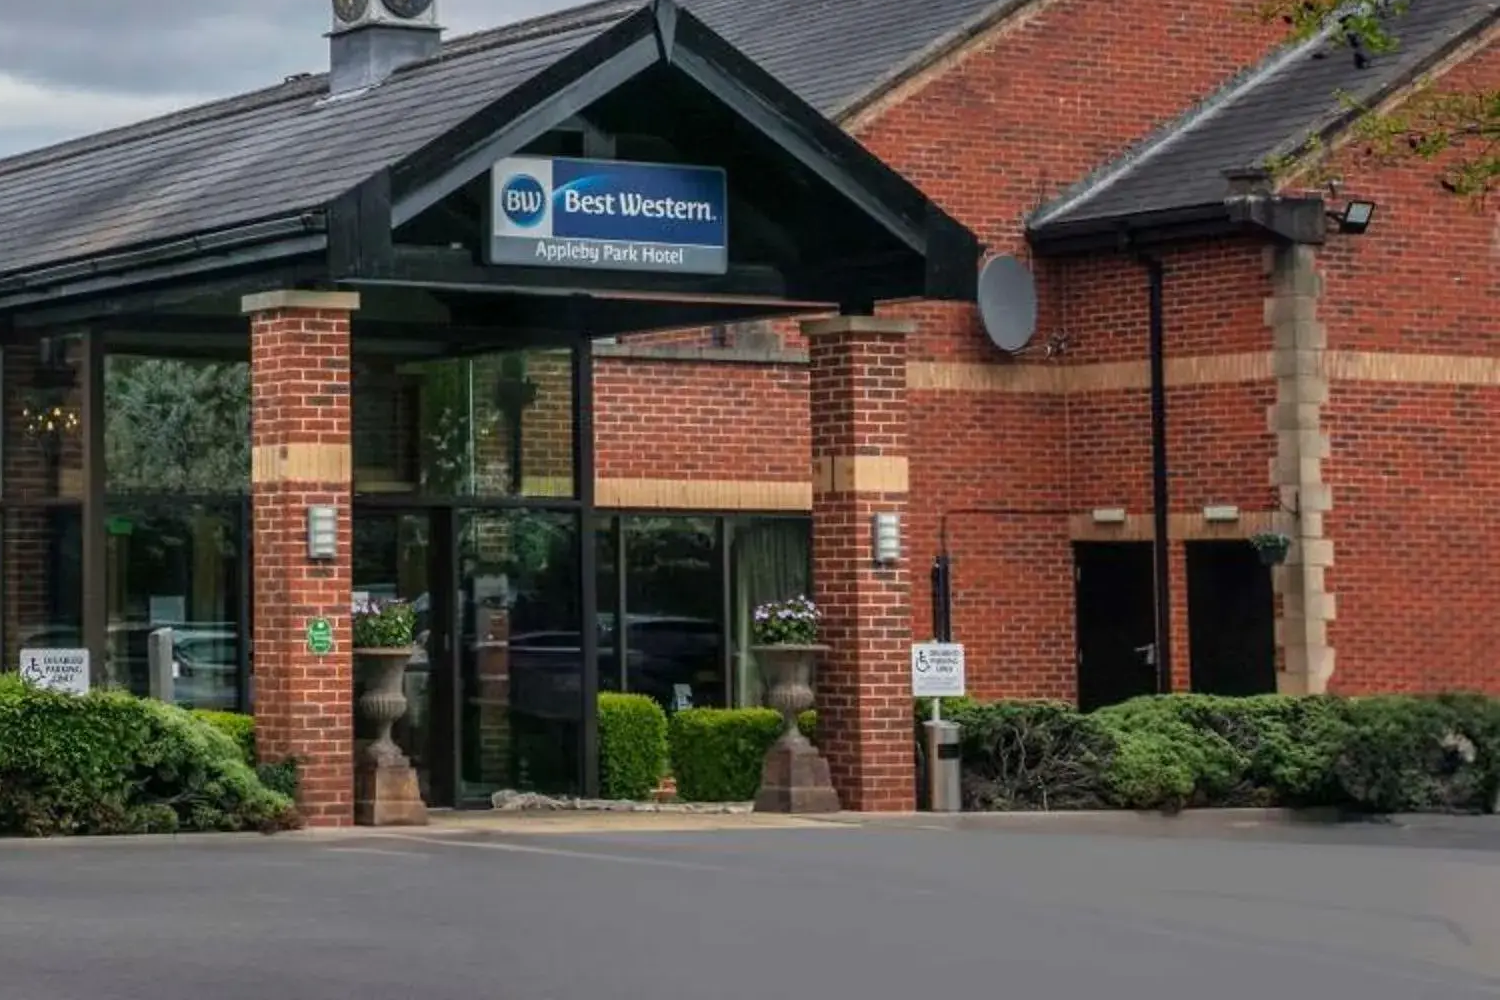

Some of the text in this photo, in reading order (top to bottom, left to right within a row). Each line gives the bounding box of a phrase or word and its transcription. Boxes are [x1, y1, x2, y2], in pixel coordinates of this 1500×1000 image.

[507, 189, 541, 212] BW
[564, 189, 615, 216] Best
[536, 241, 683, 265] Appleby Park Hotel
